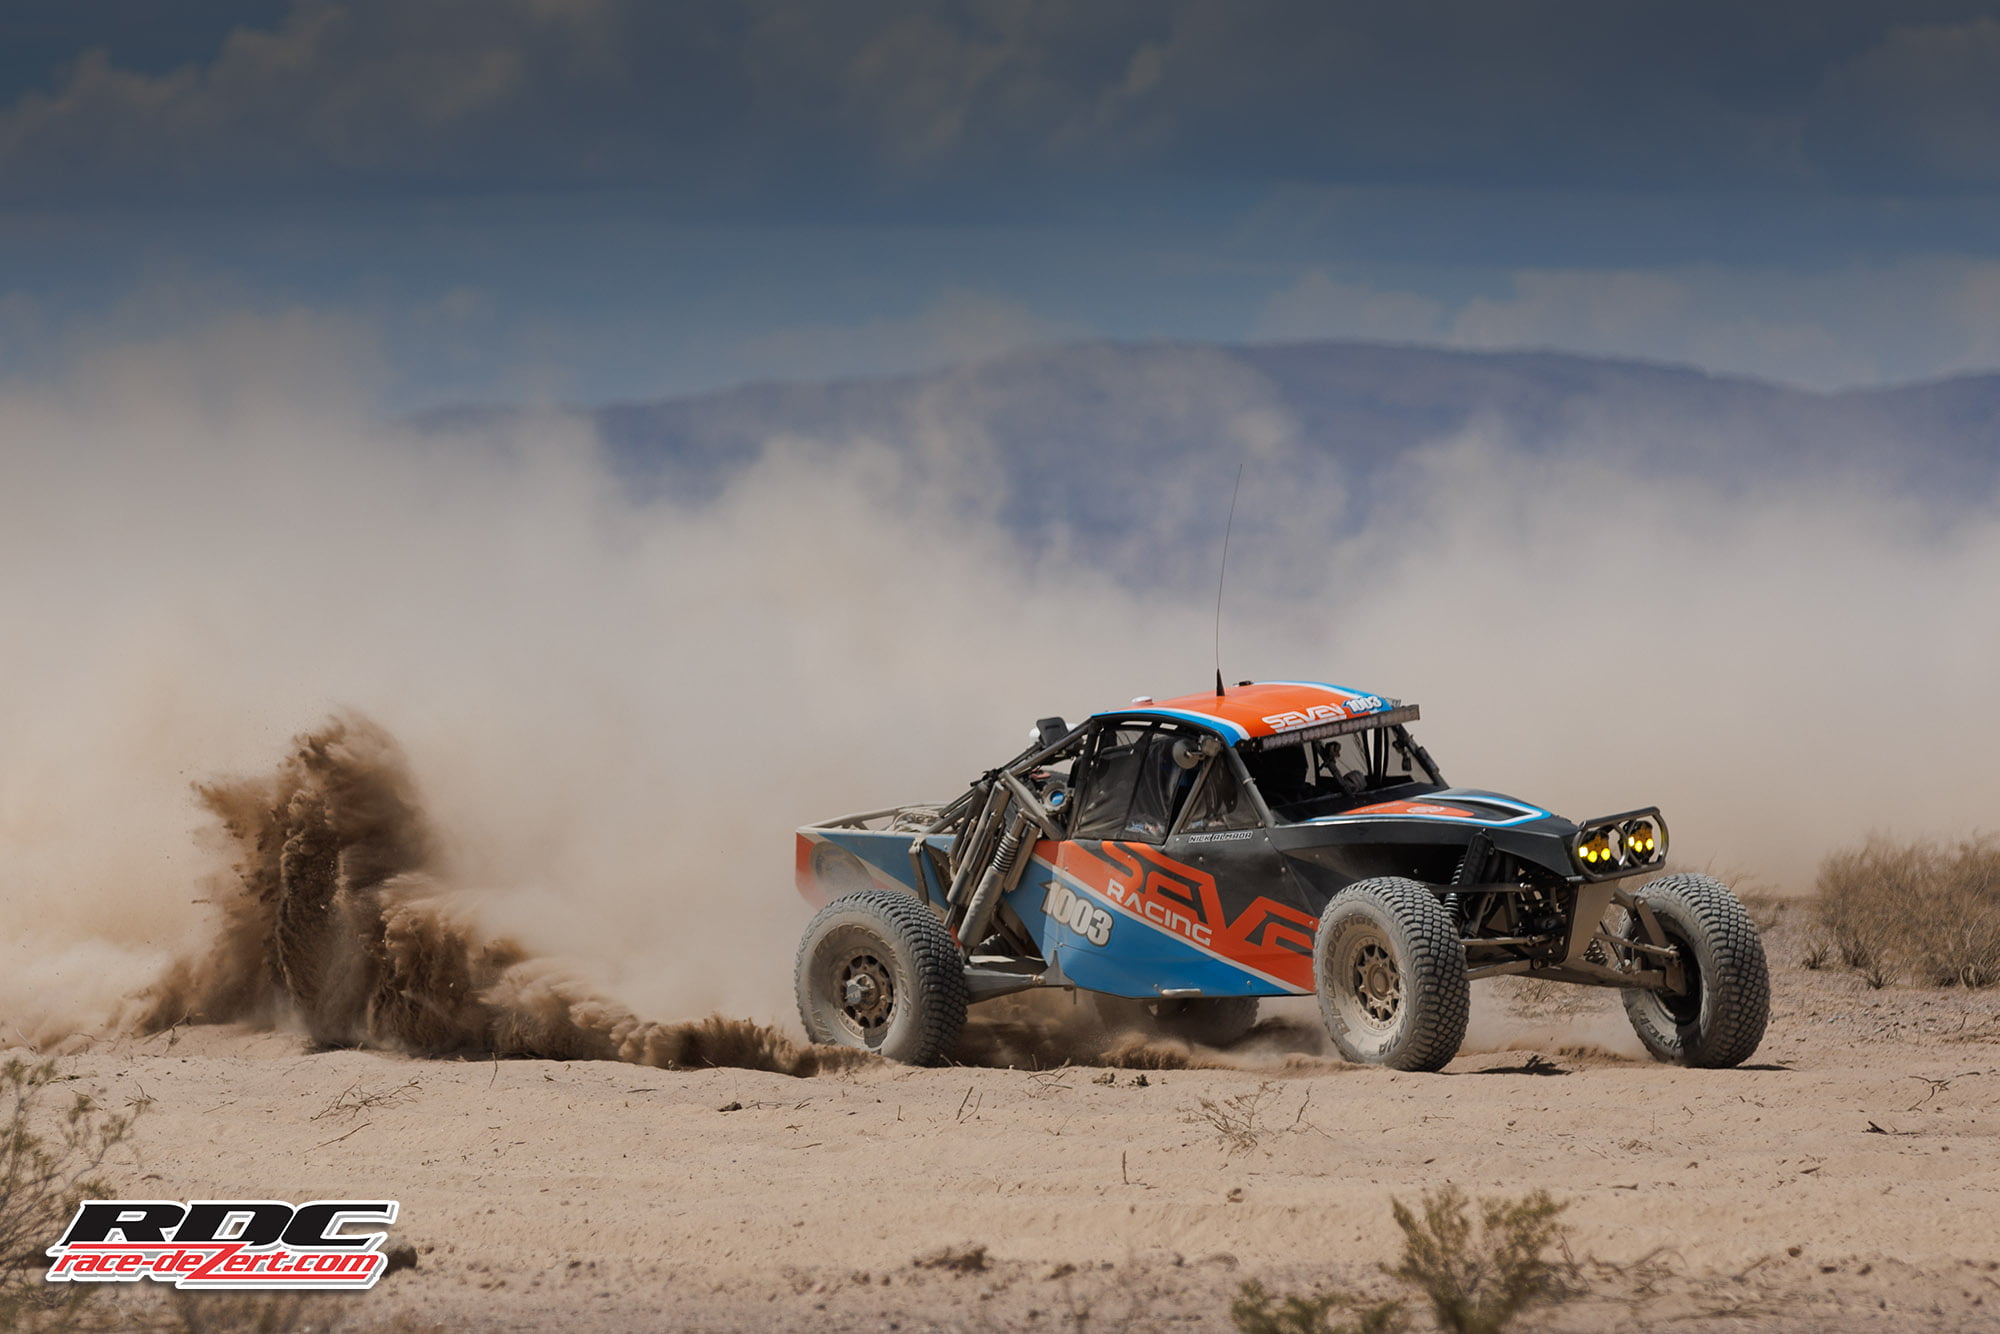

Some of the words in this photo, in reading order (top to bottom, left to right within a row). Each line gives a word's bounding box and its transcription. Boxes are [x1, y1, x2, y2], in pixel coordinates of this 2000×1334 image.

[1345, 695, 1384, 713] 1003
[1041, 879, 1113, 948] 1003
[1106, 877, 1213, 947] RACING
